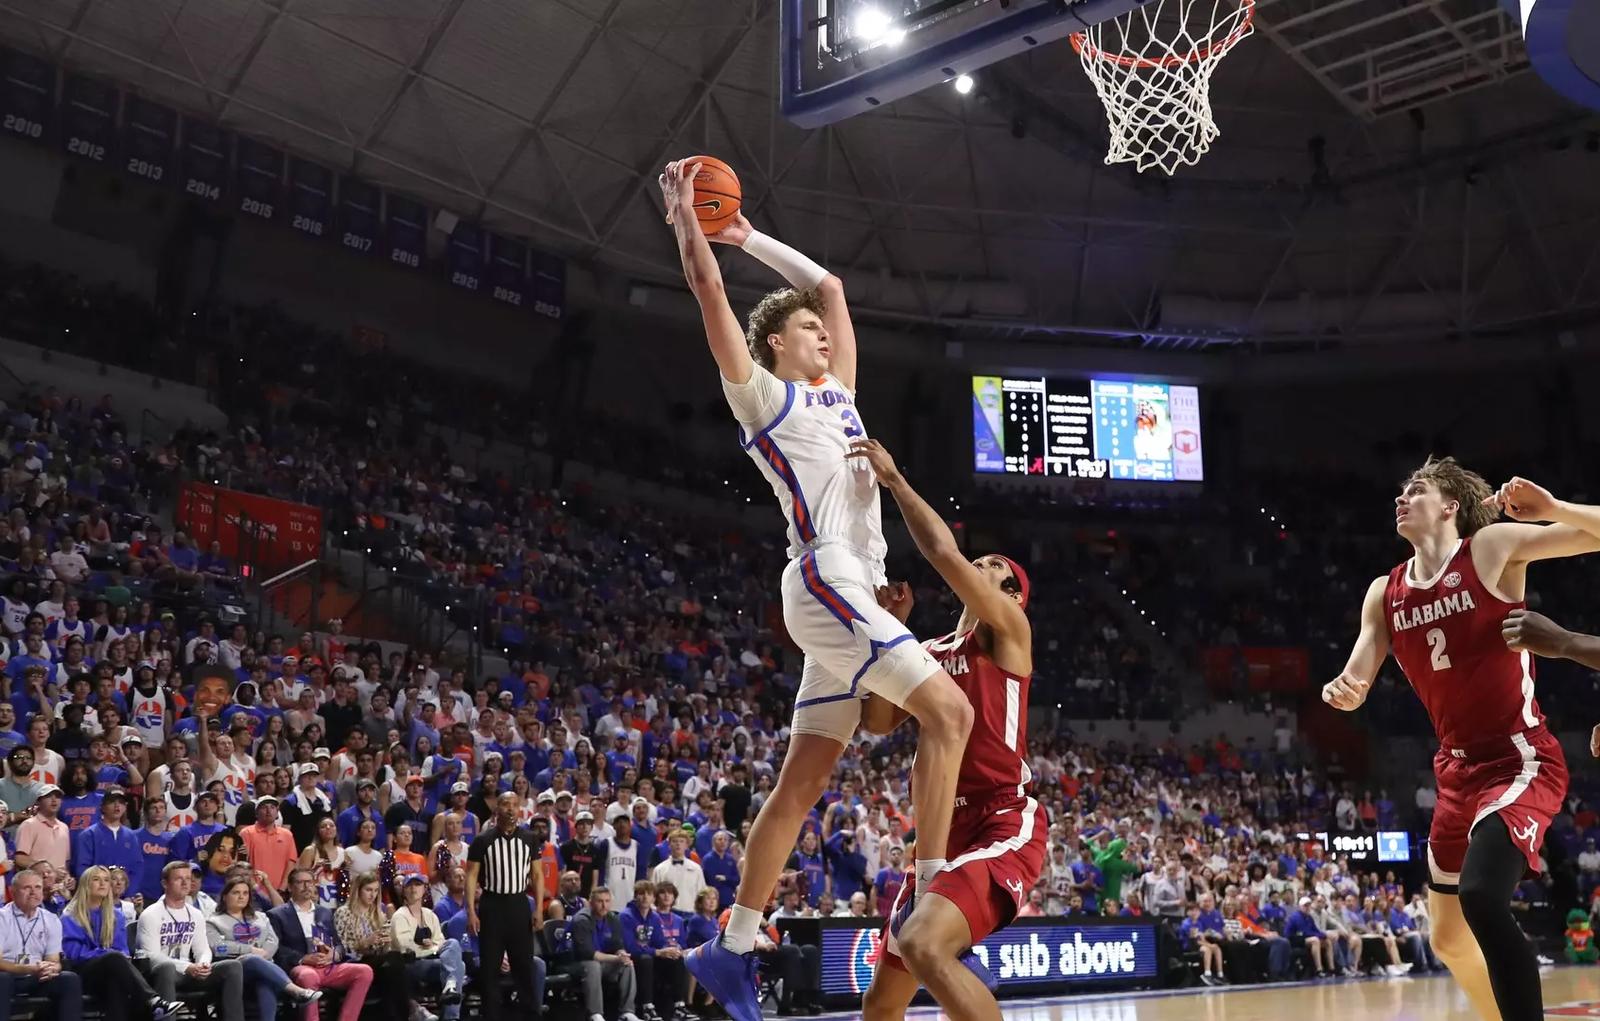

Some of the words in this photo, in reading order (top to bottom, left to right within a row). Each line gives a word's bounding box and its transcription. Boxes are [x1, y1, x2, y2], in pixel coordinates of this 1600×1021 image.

[3, 114, 42, 138] 2010
[68, 137, 105, 161] 2012
[128, 158, 163, 180] 2013
[186, 179, 220, 200] 2014
[241, 198, 273, 218] 2015
[344, 233, 372, 251] 2017
[452, 272, 478, 290] 2021
[494, 286, 521, 305] 2022
[841, 409, 863, 438] 3
[1393, 590, 1476, 632] ALABAMA
[1426, 627, 1452, 672] 2
[160, 921, 196, 934] GATORS
[1000, 933, 1050, 978] sub
